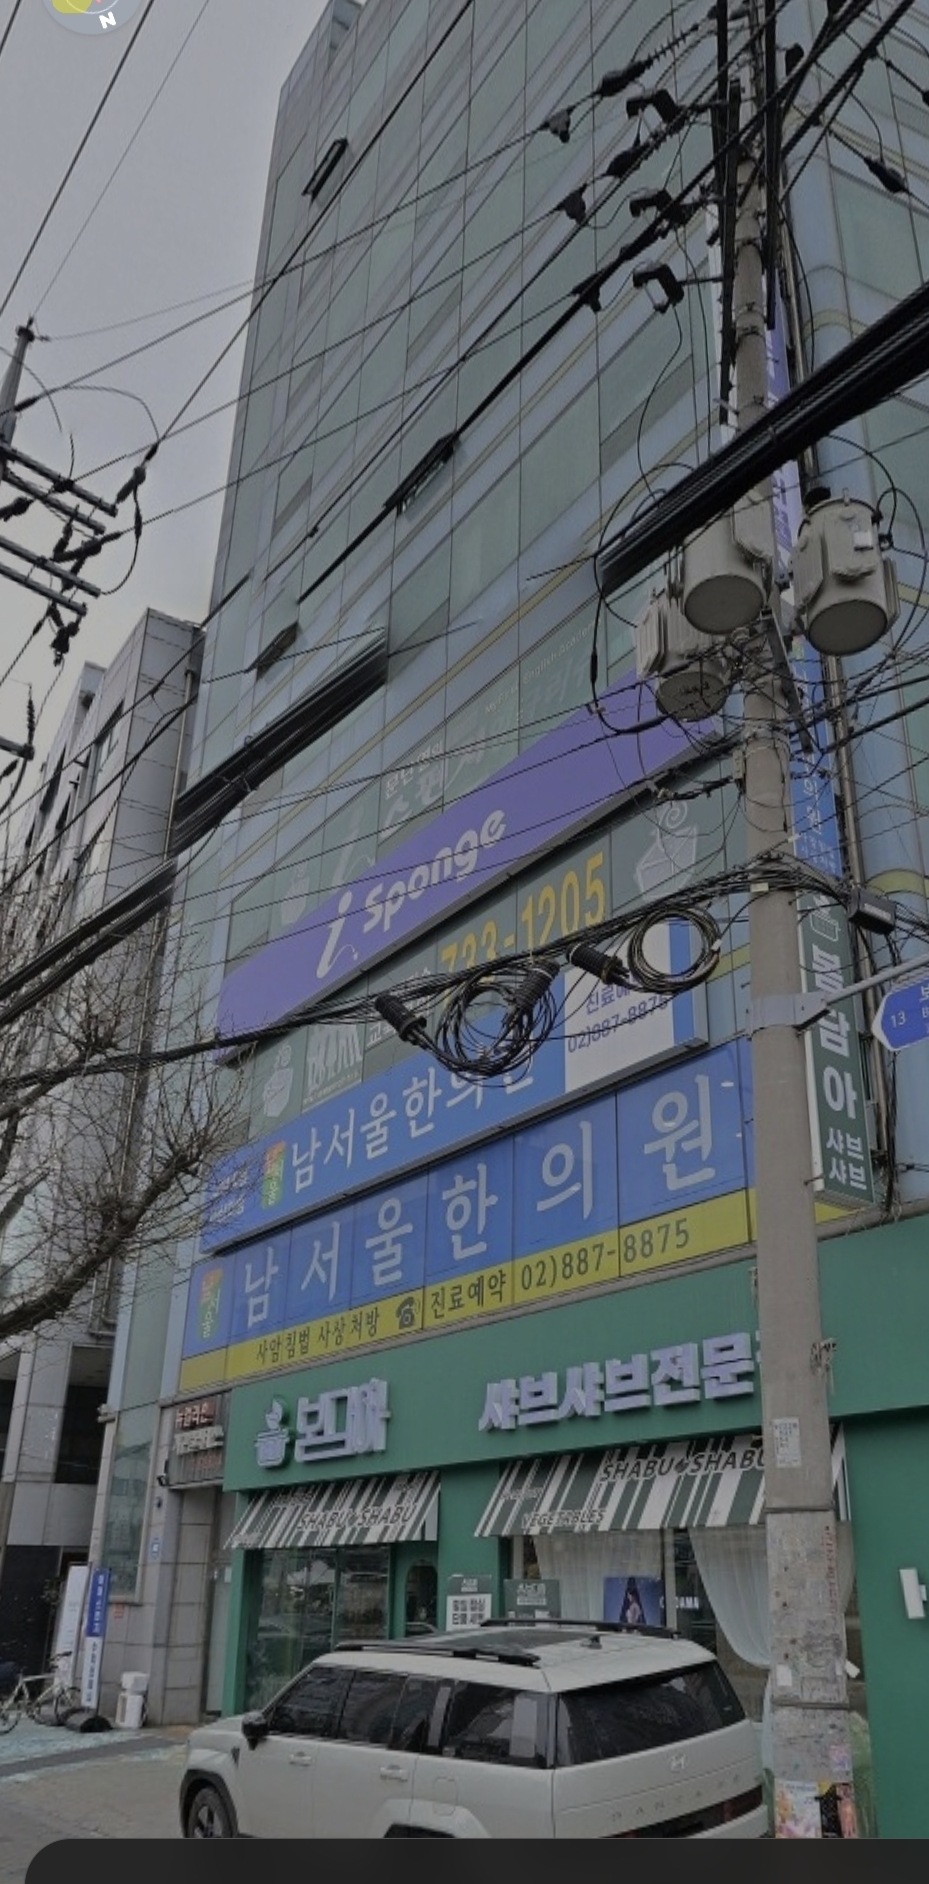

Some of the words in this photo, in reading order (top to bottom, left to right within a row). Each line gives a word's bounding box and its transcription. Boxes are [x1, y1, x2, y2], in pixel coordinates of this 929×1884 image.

[363, 809, 506, 932] Sponge
[891, 1011, 907, 1028] 13
[431, 1271, 506, 1319] 진료예약
[521, 1217, 690, 1291] 02)887-8875
[478, 1331, 760, 1431] 샤브샤브전문
[600, 1455, 674, 1482] SHABU
[689, 1448, 764, 1475] SHABU
[298, 1510, 350, 1532] SHABU
[357, 1503, 416, 1528] SHABU
